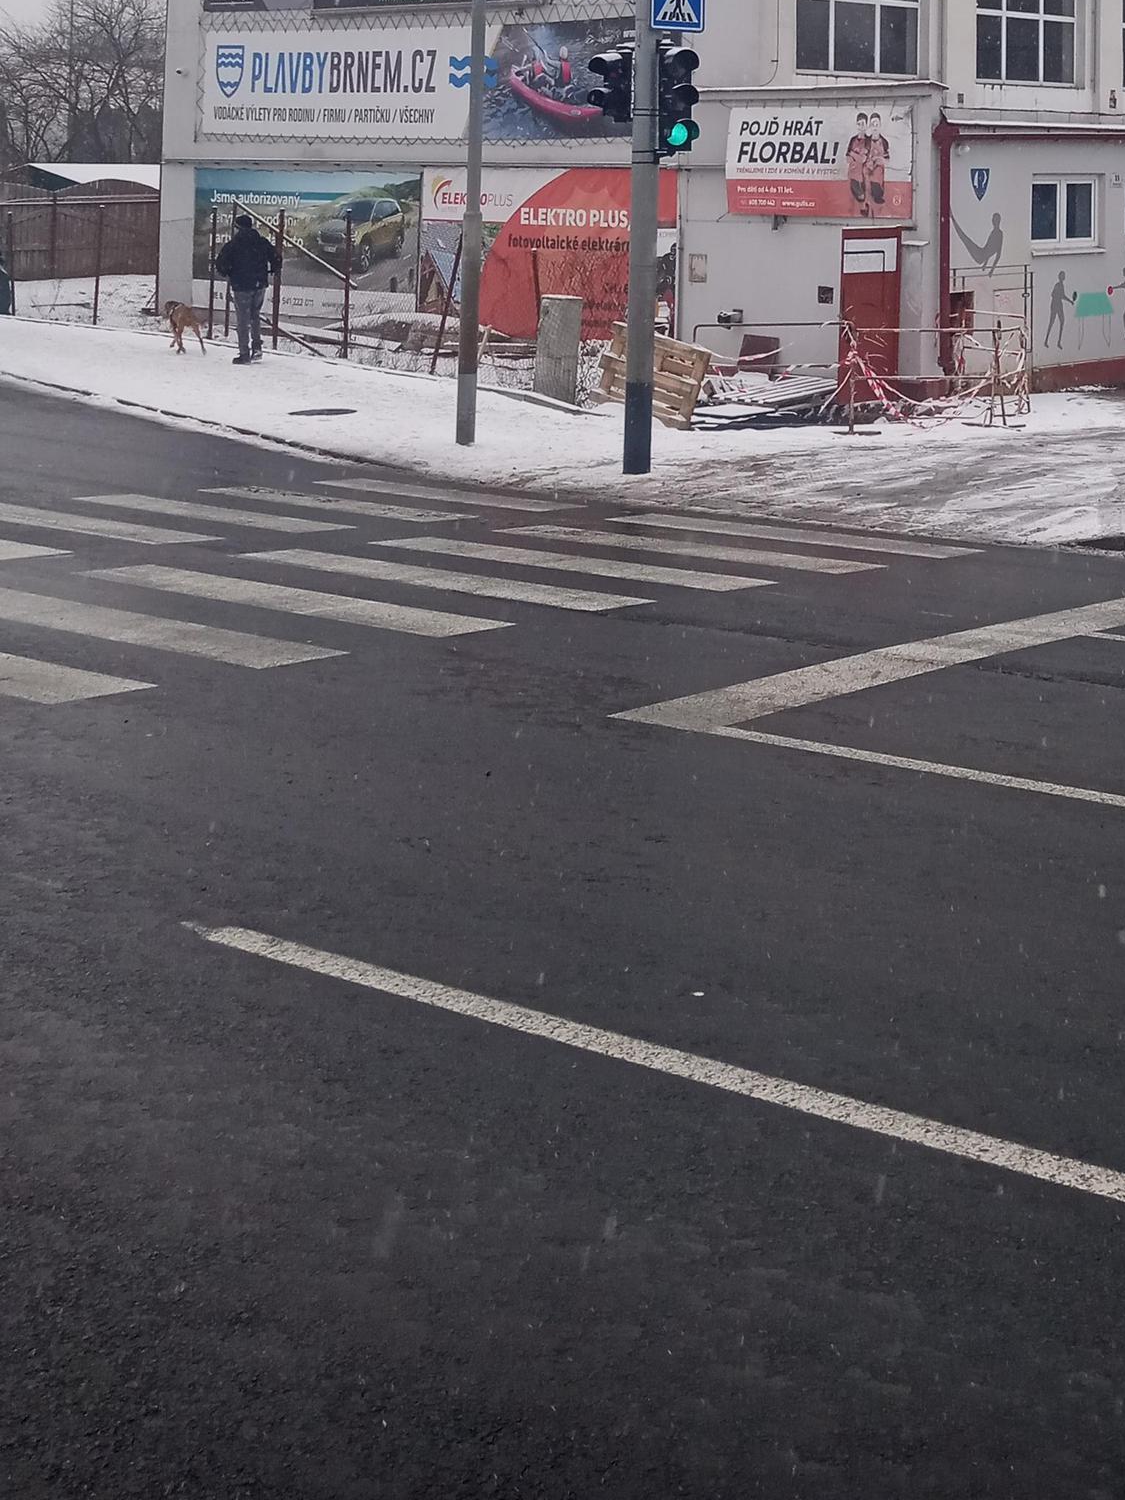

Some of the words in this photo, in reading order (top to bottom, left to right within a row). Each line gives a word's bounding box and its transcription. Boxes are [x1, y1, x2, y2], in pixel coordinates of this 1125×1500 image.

[251, 49, 438, 94] PLAVBYBRNEM.CZ
[213, 103, 245, 120] VODÁCKÉ
[245, 103, 272, 121] VÝLETY
[272, 107, 287, 122] PRO
[288, 108, 315, 122] RODINU
[323, 108, 346, 123] FIRMU
[354, 105, 391, 123] PARTIČKU
[399, 105, 435, 123] VŠECHNY
[740, 116, 779, 136] POJĎ
[782, 116, 823, 136] HRÁT
[737, 141, 839, 164] FLORBAL!
[210, 190, 237, 204] Jsme
[238, 191, 300, 209] autorizovaný
[441, 192, 513, 207] ELEKOPLUS
[520, 207, 586, 227] ELEKTRO
[589, 209, 631, 232] PLUS,
[508, 233, 579, 250] fotovoltaické
